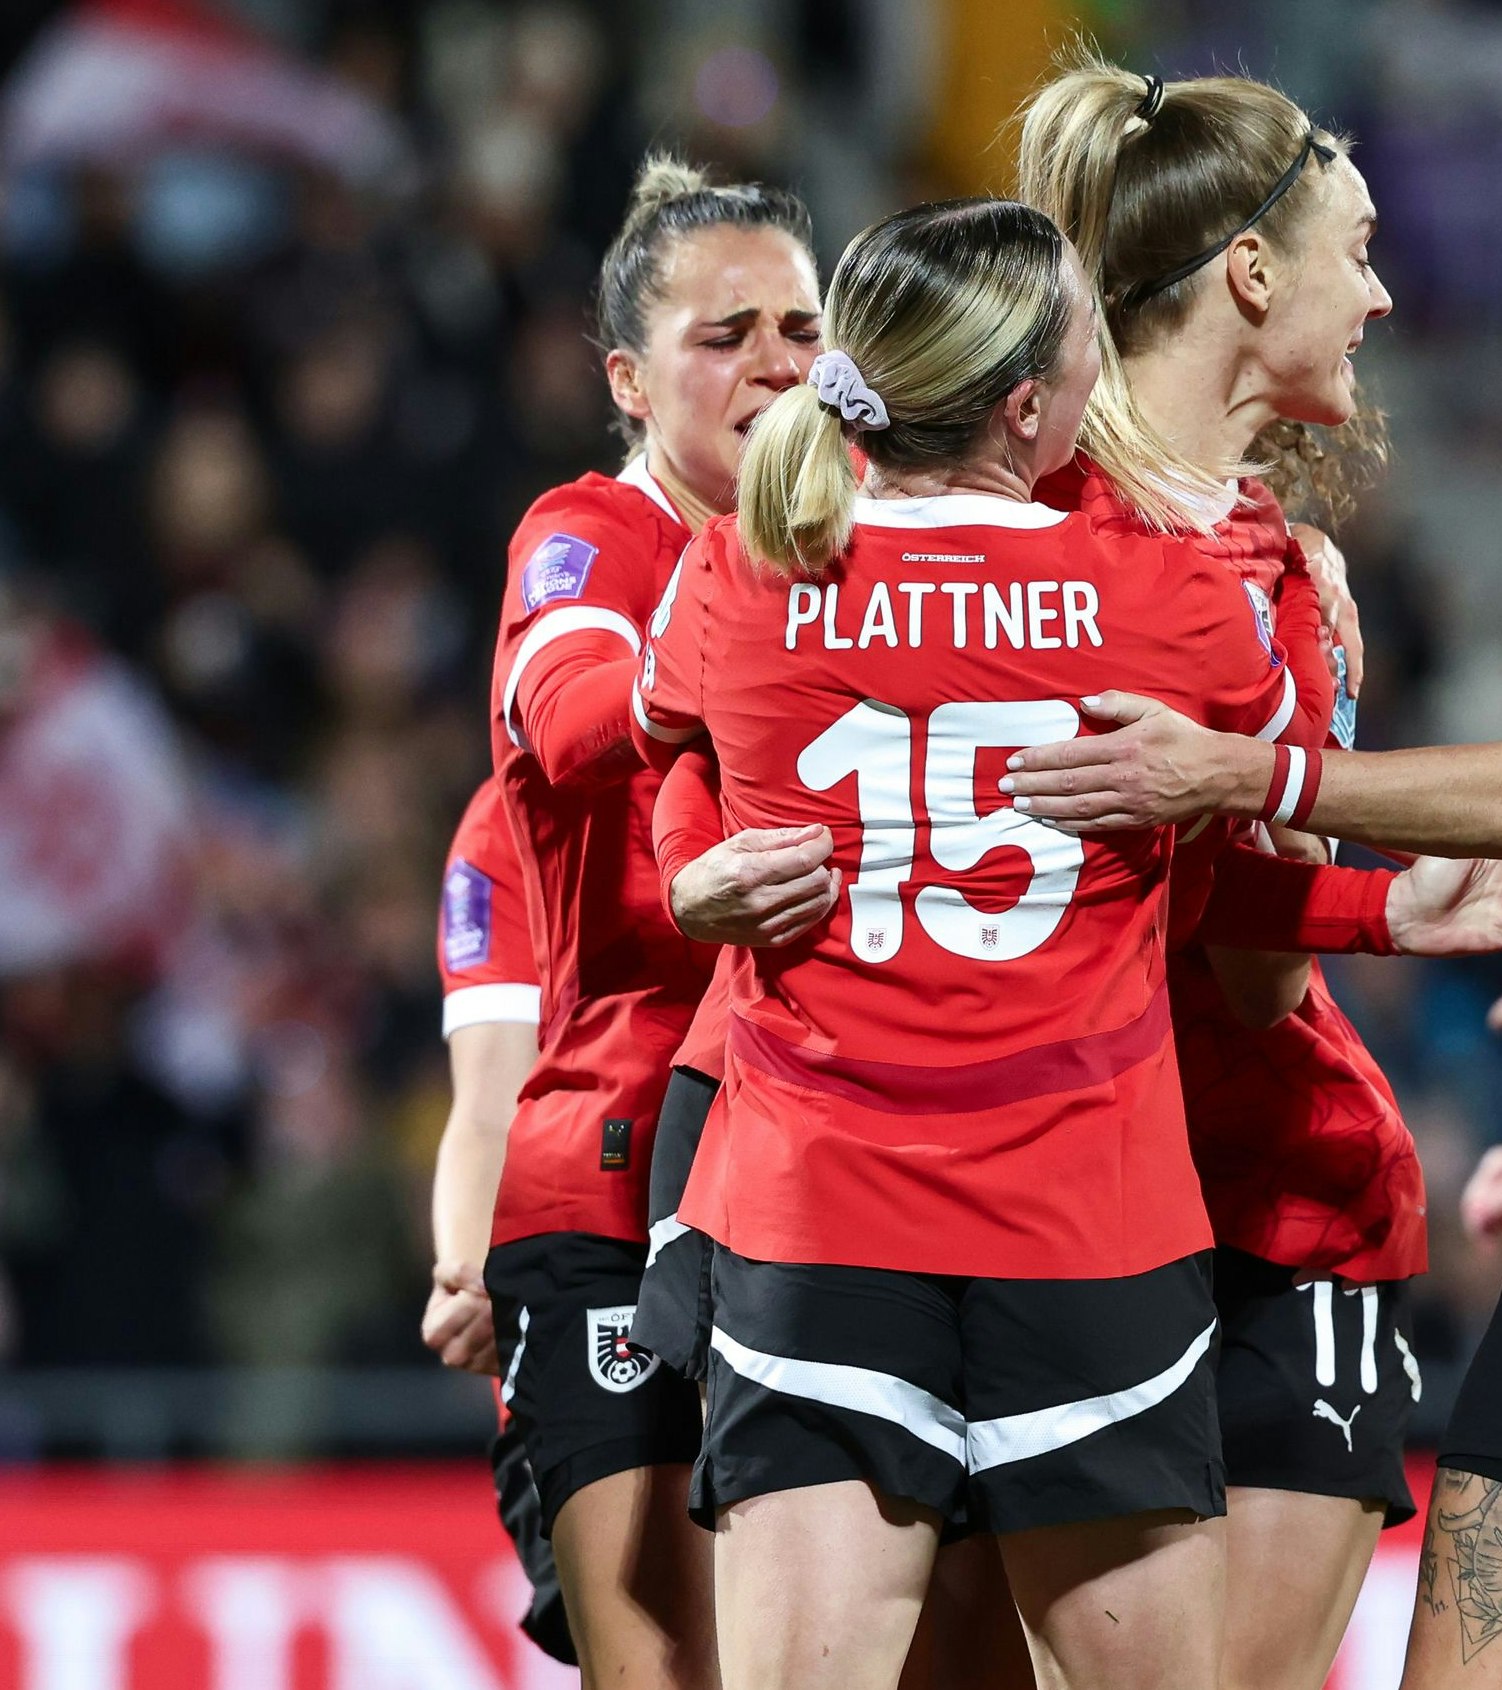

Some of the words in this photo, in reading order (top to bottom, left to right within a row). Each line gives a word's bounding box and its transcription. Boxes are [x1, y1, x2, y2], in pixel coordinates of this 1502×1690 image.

[902, 552, 985, 563] ÖSTERREICH
[785, 581, 1103, 649] PLATTNER
[796, 698, 1084, 964] 15
[1295, 1281, 1379, 1395] 11
